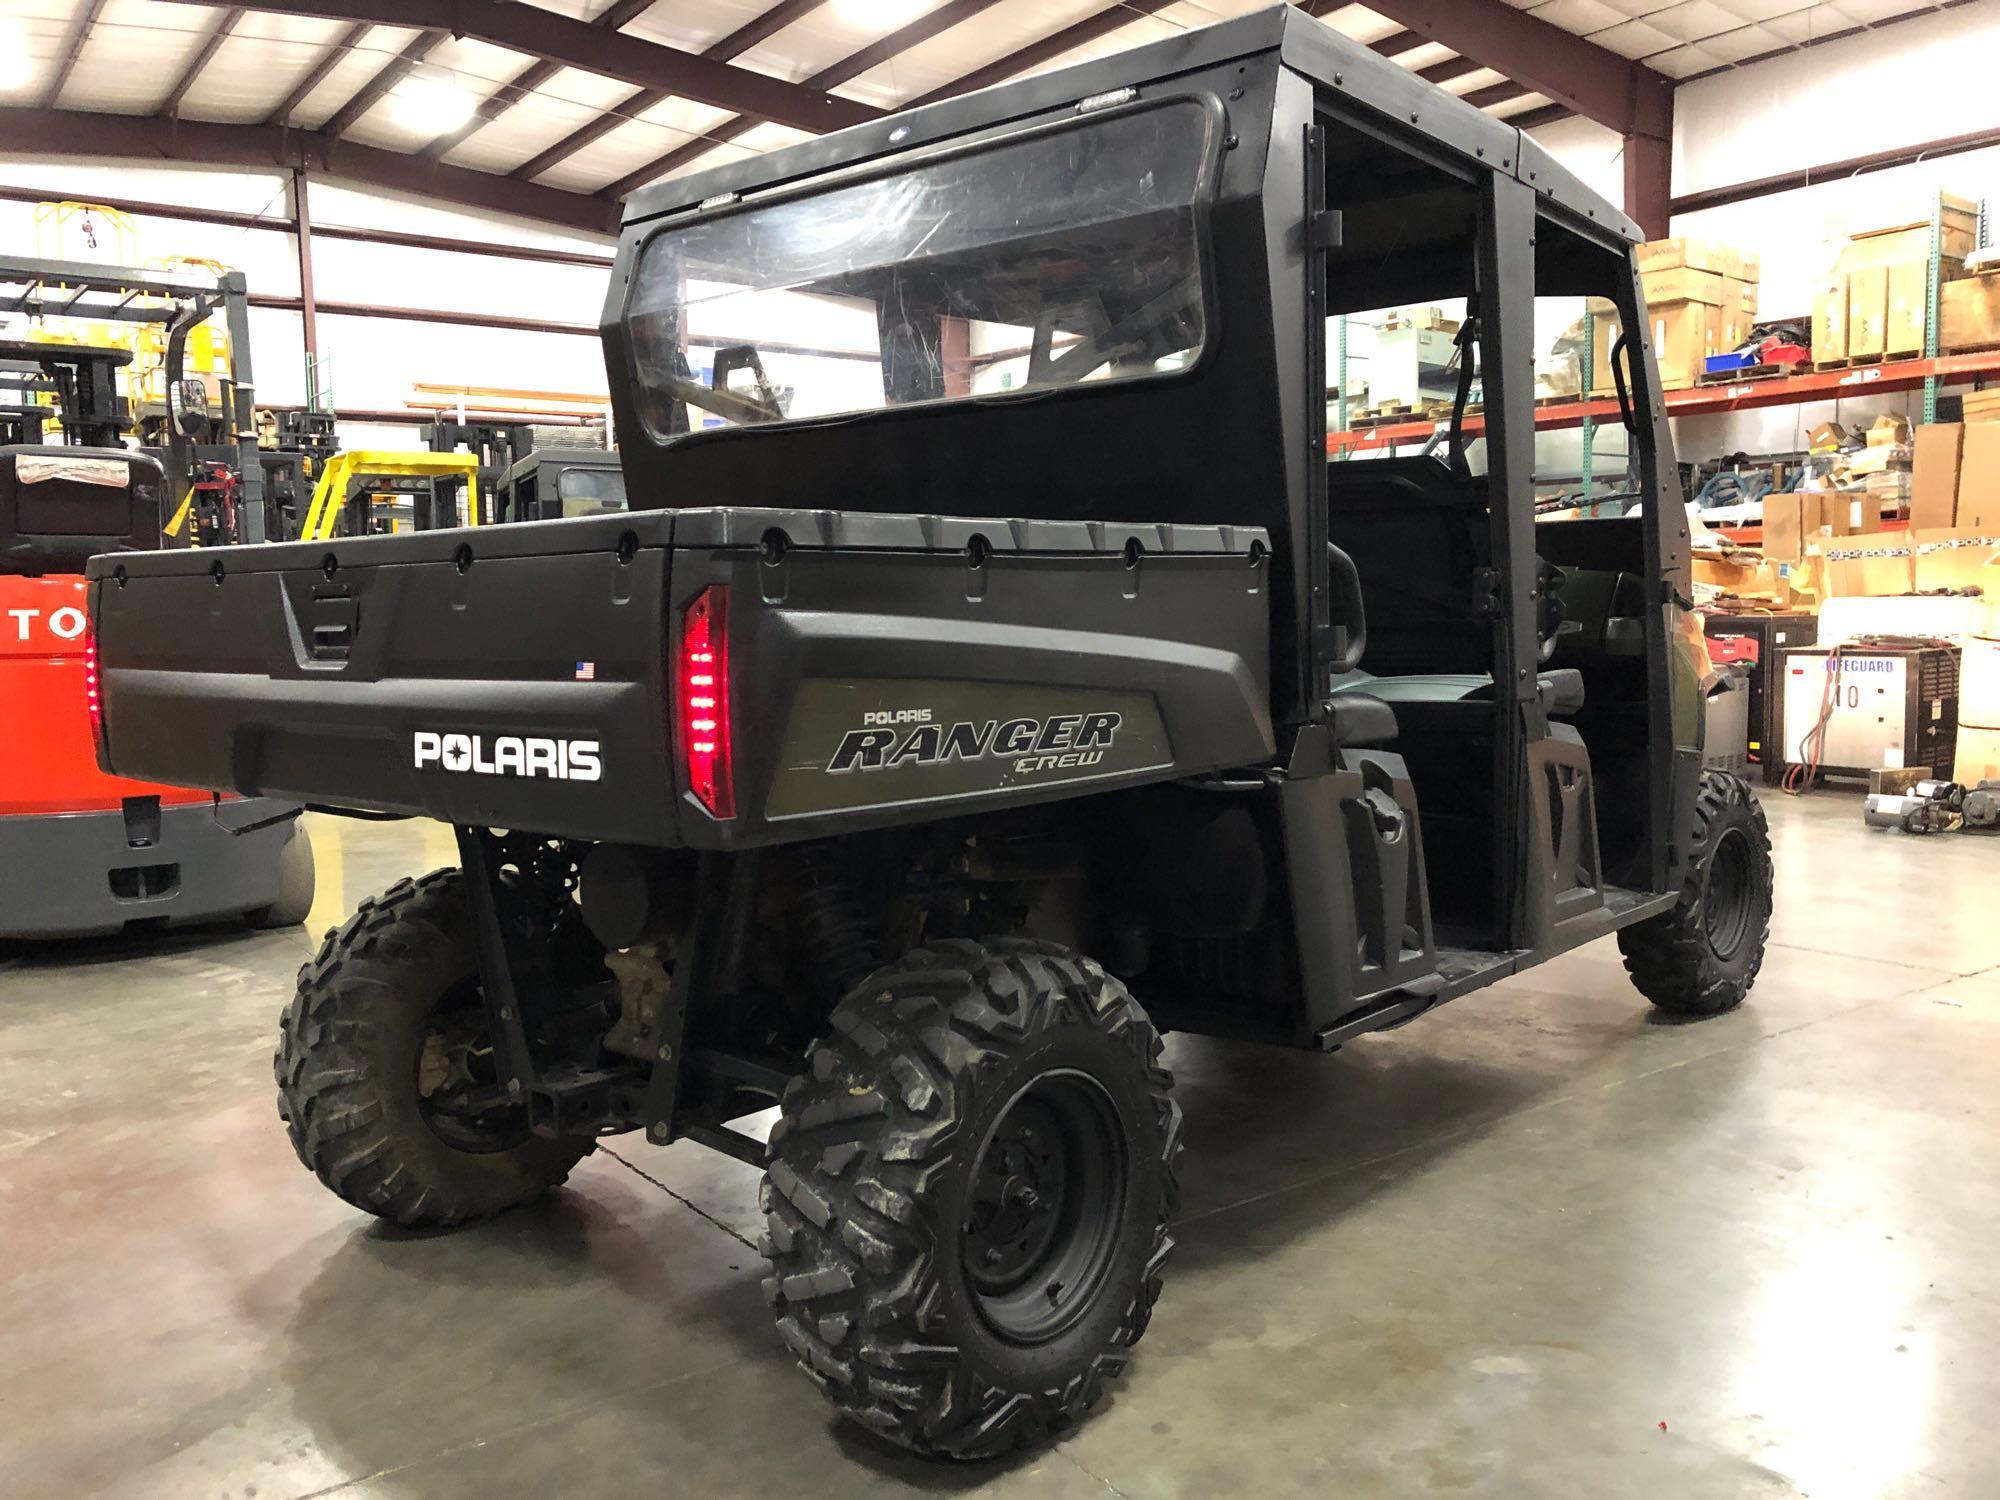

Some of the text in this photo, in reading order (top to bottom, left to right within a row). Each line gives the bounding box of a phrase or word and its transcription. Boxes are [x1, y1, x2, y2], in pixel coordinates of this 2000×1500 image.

[8, 607, 87, 640] TO
[863, 709, 932, 726] POLARIS
[414, 731, 602, 782] POLARIS
[826, 712, 1123, 774] RANGER
[1014, 750, 1104, 774] CREW
